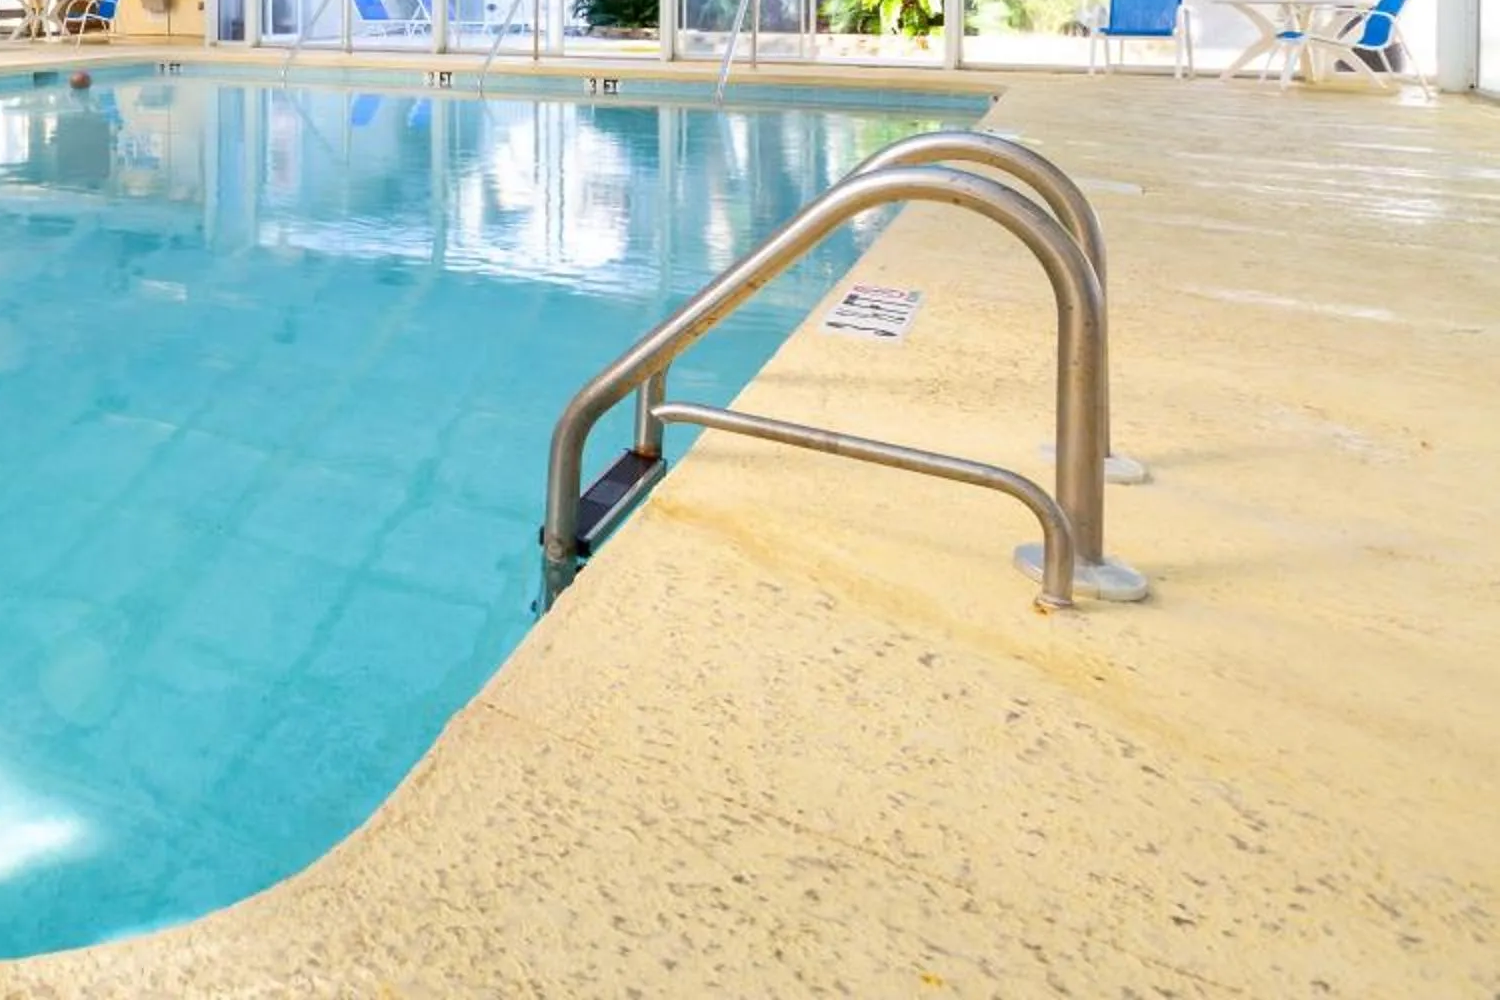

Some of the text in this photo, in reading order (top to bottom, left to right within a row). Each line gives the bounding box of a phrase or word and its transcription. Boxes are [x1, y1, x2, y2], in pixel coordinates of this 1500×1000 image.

[440, 71, 453, 88] FT
[589, 78, 619, 95] 3 FT
